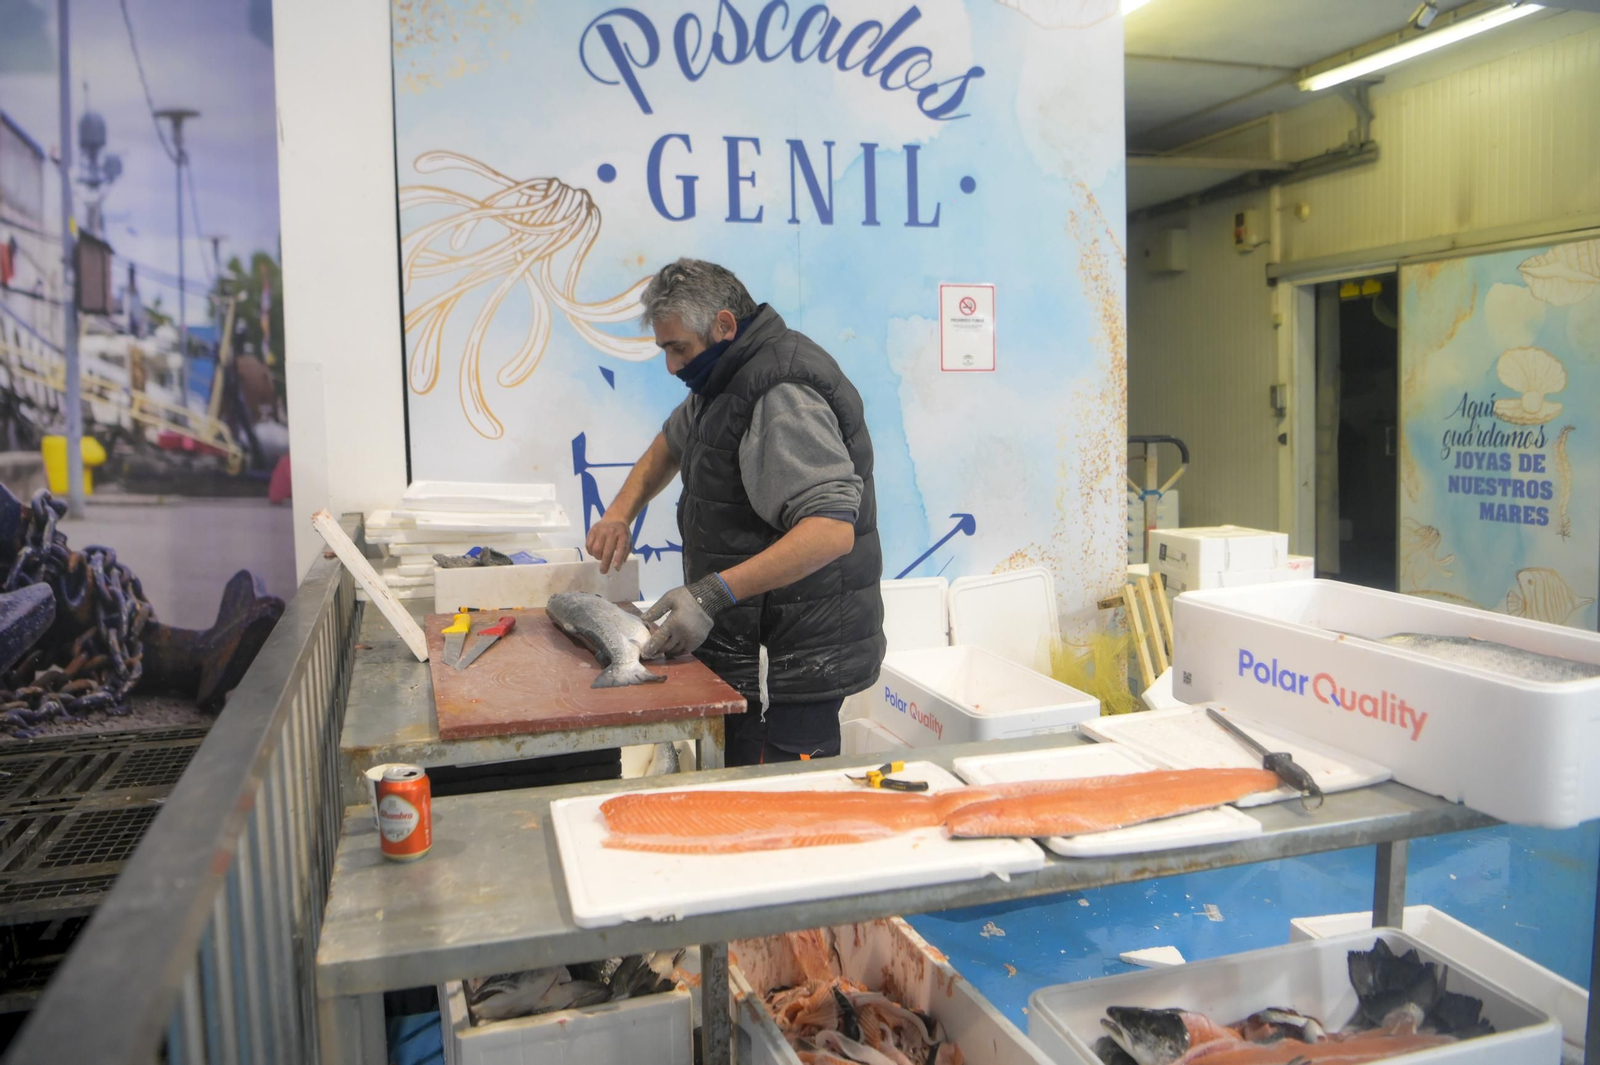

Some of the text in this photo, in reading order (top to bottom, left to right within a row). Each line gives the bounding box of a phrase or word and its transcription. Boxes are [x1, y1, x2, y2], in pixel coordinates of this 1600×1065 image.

[579, 0, 985, 121] Pescados
[646, 133, 941, 228] GENIL
[1440, 422, 1548, 460] guardamos
[1454, 451, 1546, 473] JOYAS DE
[1448, 475, 1553, 500] NUESTROS
[1479, 502, 1549, 526] MARES
